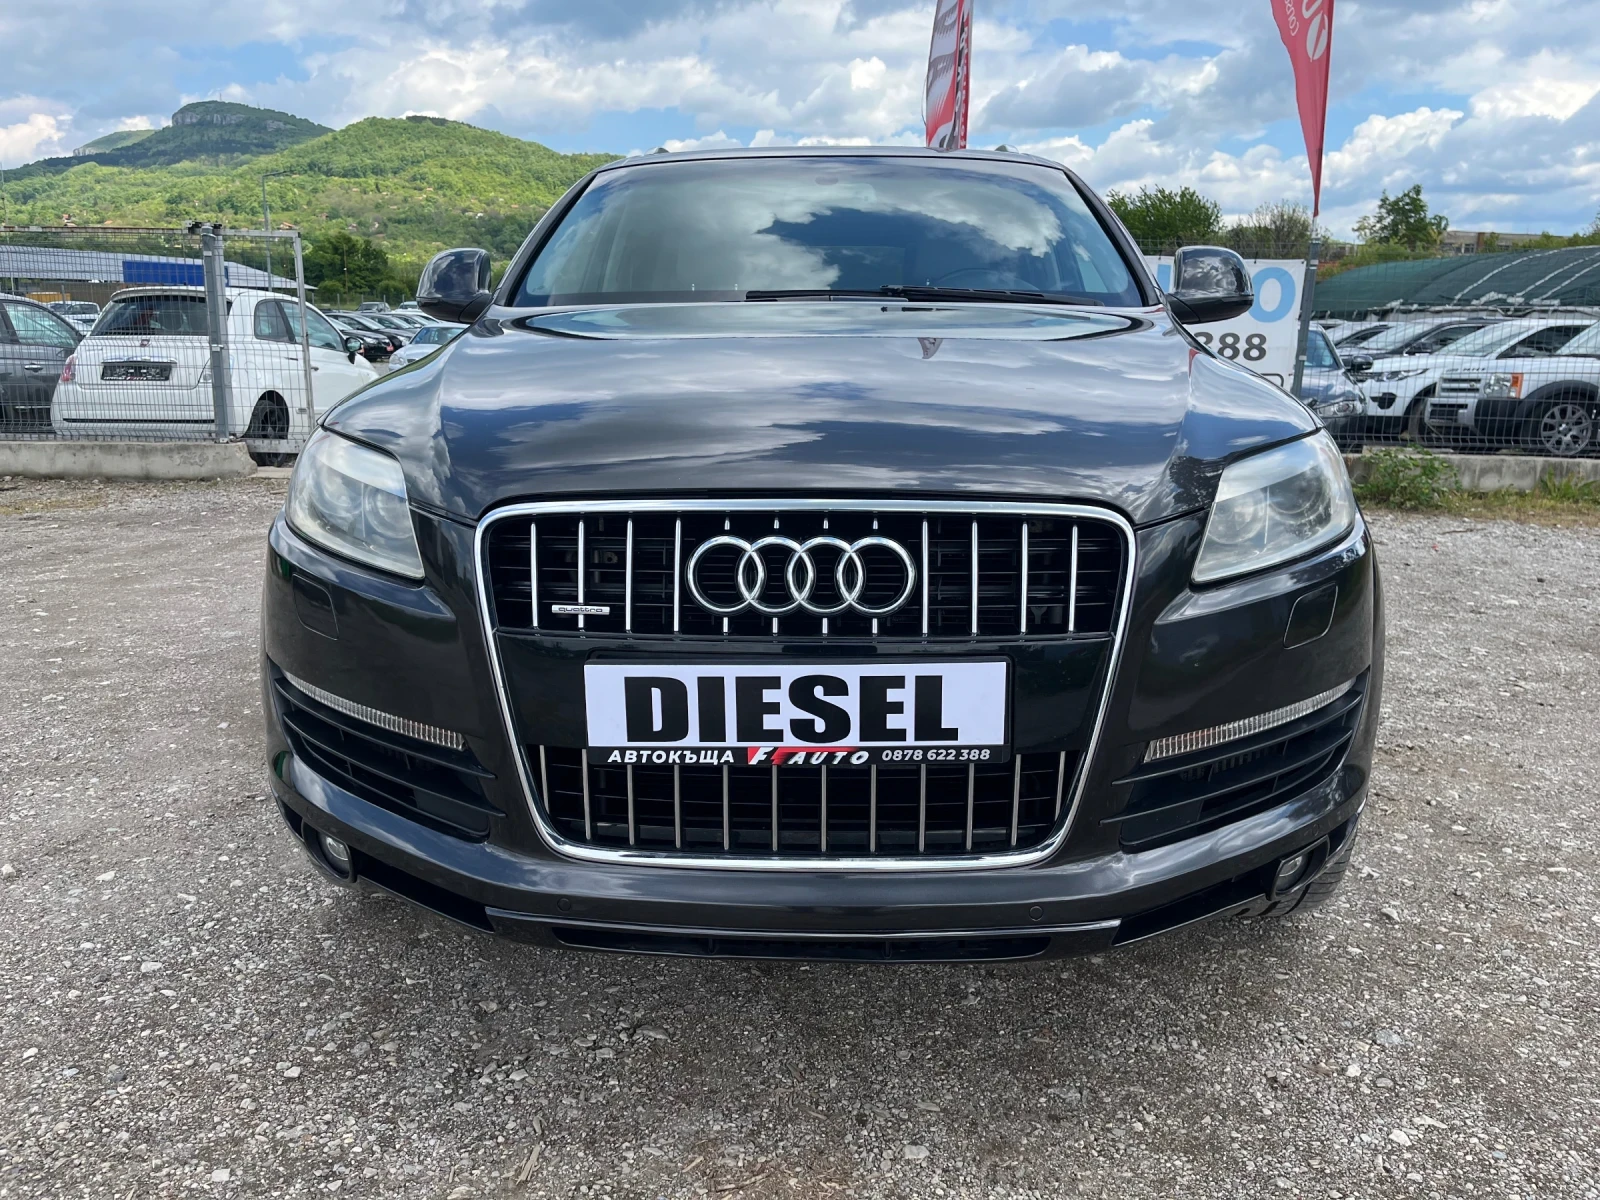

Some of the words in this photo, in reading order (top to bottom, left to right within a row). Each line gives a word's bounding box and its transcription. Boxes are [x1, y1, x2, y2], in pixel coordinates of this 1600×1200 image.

[623, 674, 959, 744] DIESEL
[607, 749, 735, 765] АВТОКЪЩА
[881, 749, 923, 761] 0878
[927, 749, 956, 760] 622
[959, 749, 990, 760] 388
